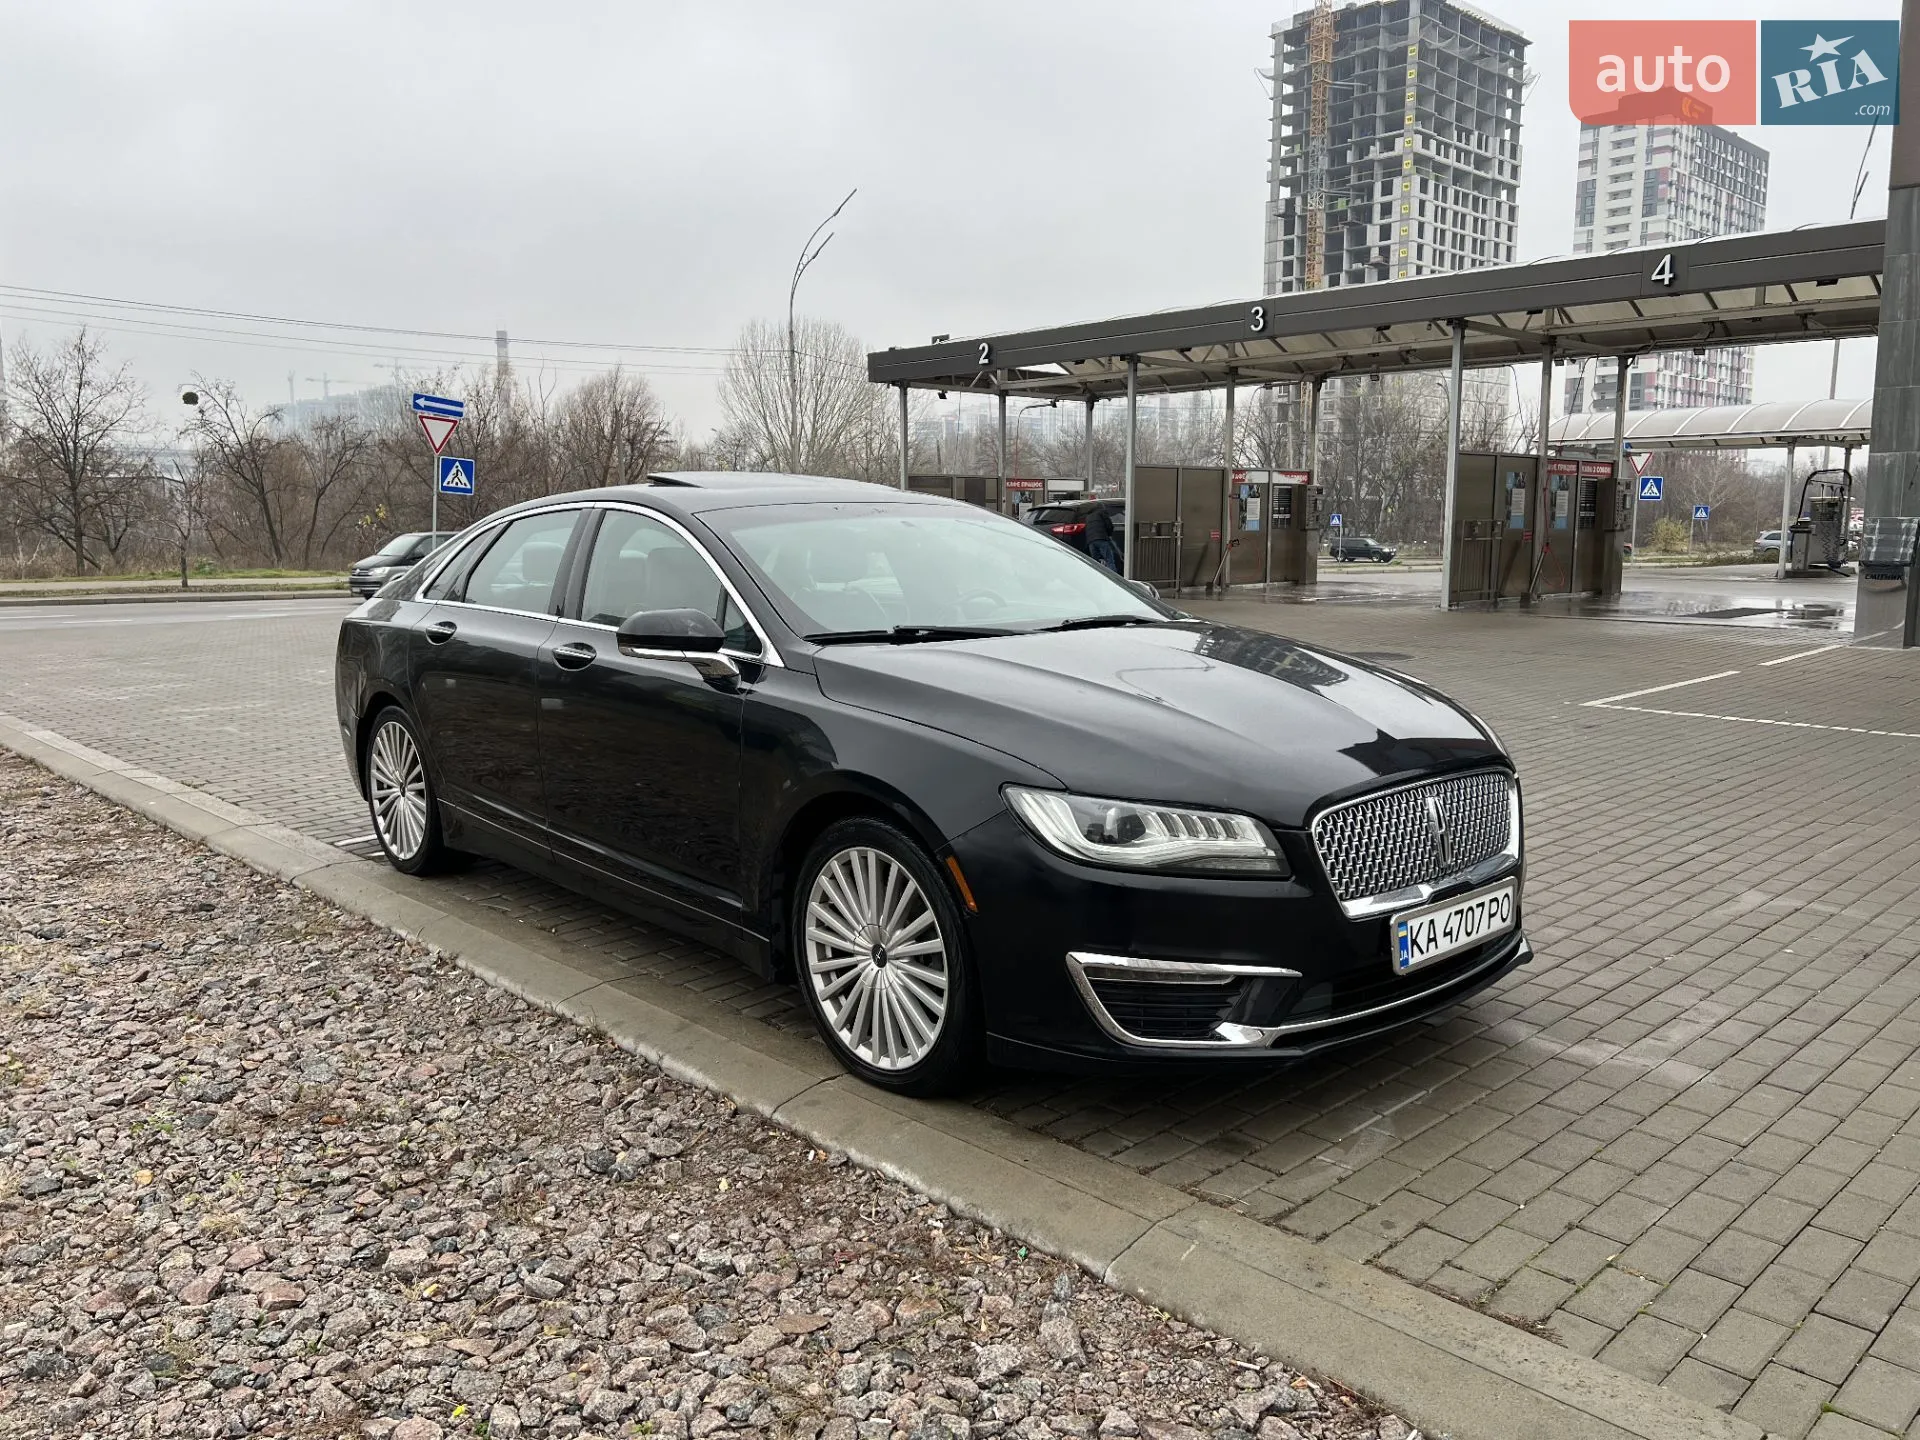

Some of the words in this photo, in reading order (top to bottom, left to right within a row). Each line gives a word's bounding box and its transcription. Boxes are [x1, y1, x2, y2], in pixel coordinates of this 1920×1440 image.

[1651, 253, 1674, 285] 4
[1250, 306, 1264, 332] 3
[978, 342, 989, 365] 2
[1409, 918, 1438, 958] KA
[1443, 901, 1485, 945] 4707
[1487, 892, 1511, 930] PO
